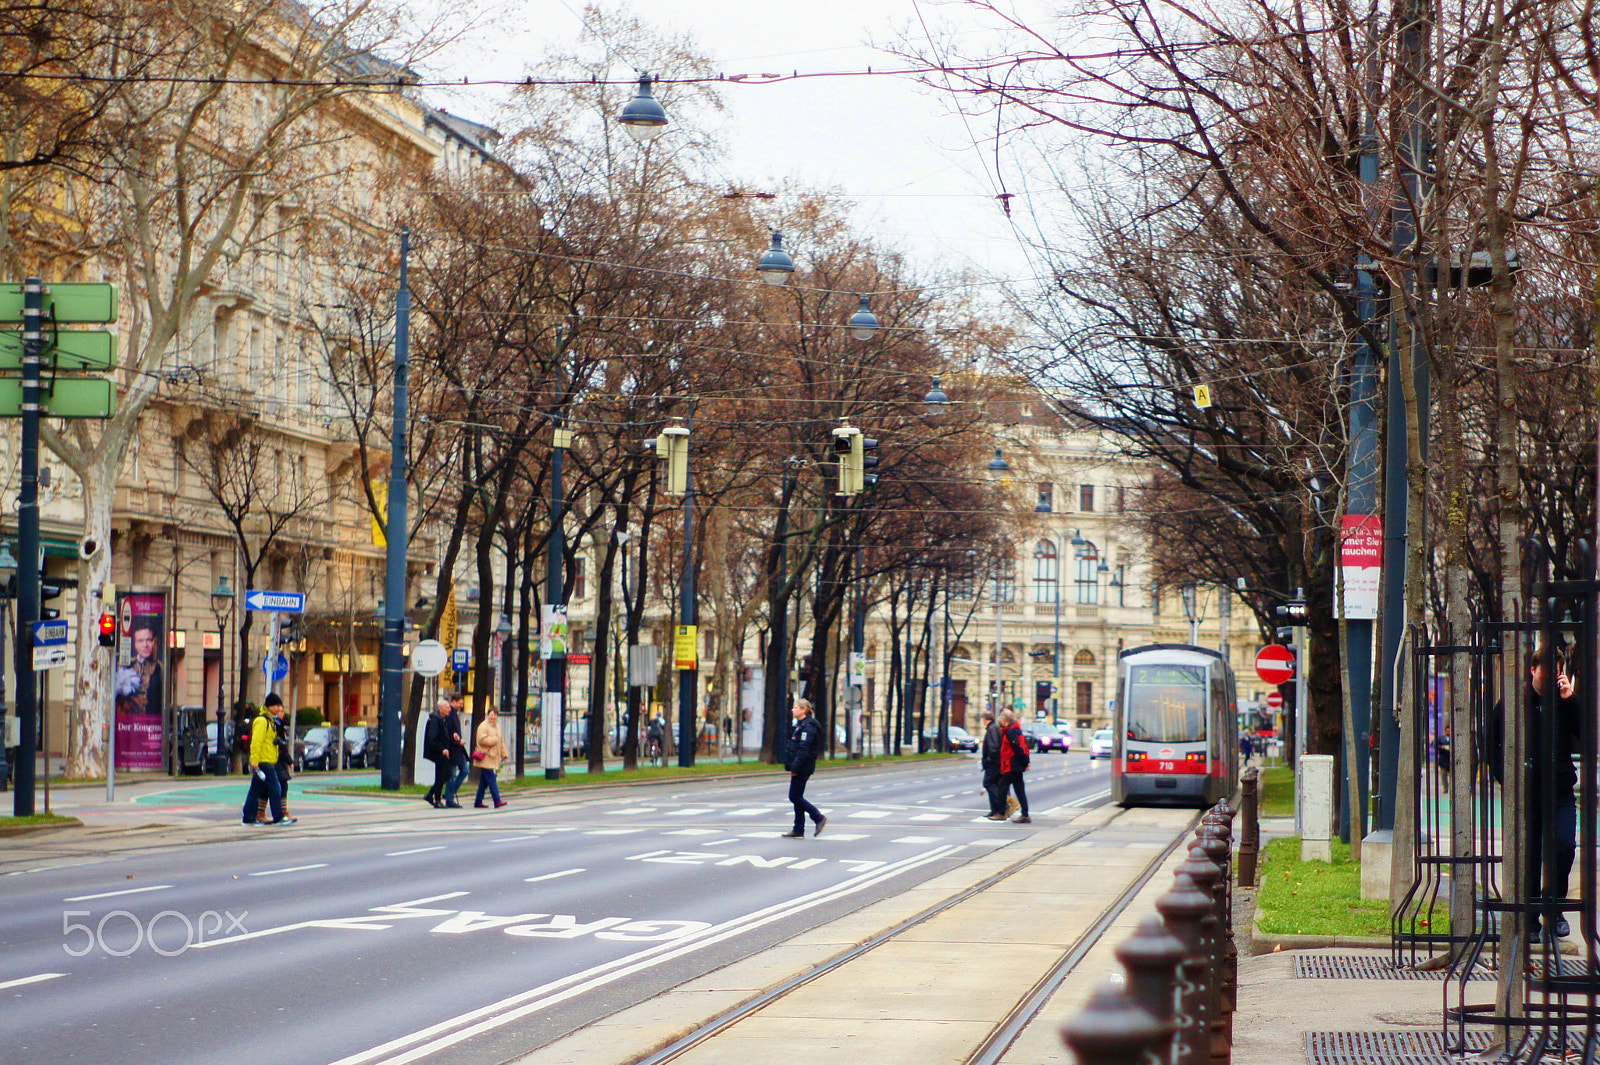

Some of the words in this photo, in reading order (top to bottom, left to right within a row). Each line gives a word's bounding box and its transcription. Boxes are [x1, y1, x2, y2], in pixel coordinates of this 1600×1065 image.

[1198, 389, 1207, 401] A
[264, 596, 297, 607] EINBAHN
[444, 596, 456, 651] Wolfskin
[1139, 669, 1148, 683] 2
[118, 722, 132, 731] Der
[1158, 761, 1175, 771] 710
